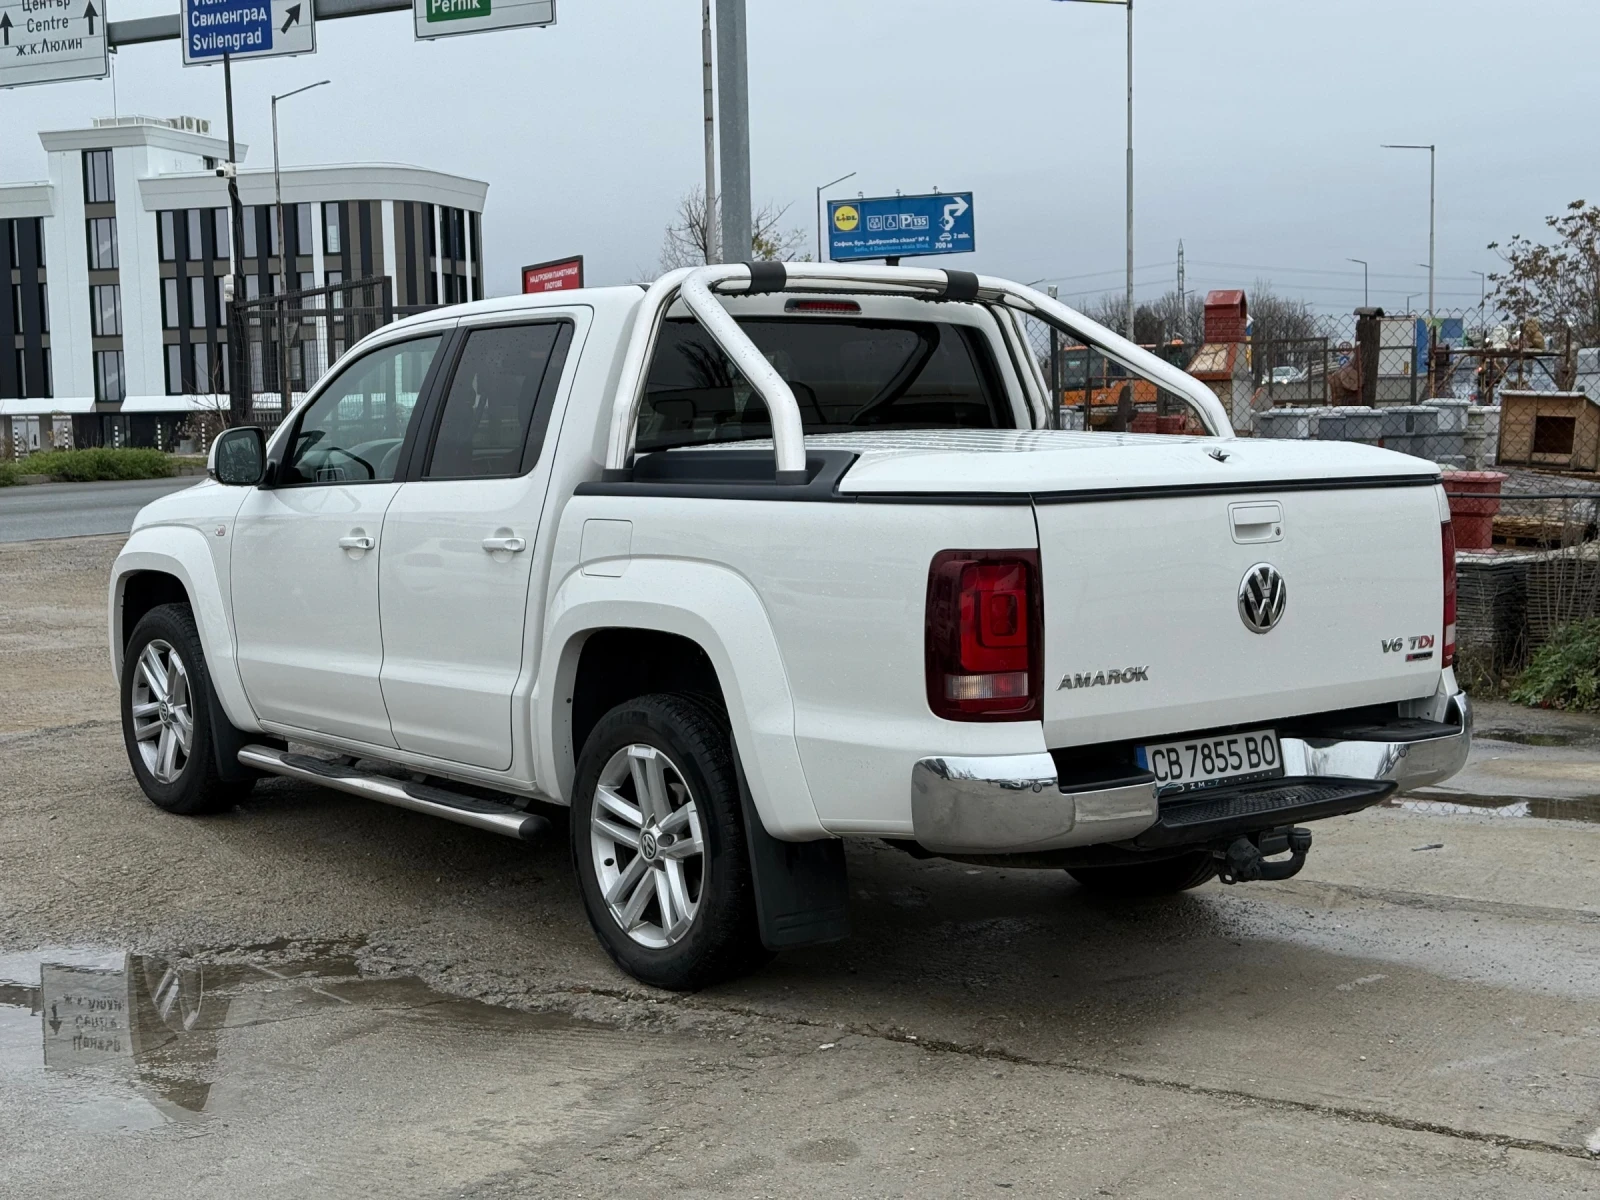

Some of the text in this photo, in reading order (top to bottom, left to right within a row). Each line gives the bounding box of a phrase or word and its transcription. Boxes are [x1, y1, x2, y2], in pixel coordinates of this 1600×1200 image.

[27, 16, 69, 33] Centre
[192, 7, 267, 27] Свиленград
[193, 27, 262, 50] Svilengrad
[914, 217, 927, 226] 135
[1381, 634, 1435, 654] V6 TDI
[1056, 665, 1149, 691] AMAROK
[1152, 747, 1183, 782] CB
[1185, 739, 1243, 778] 7855
